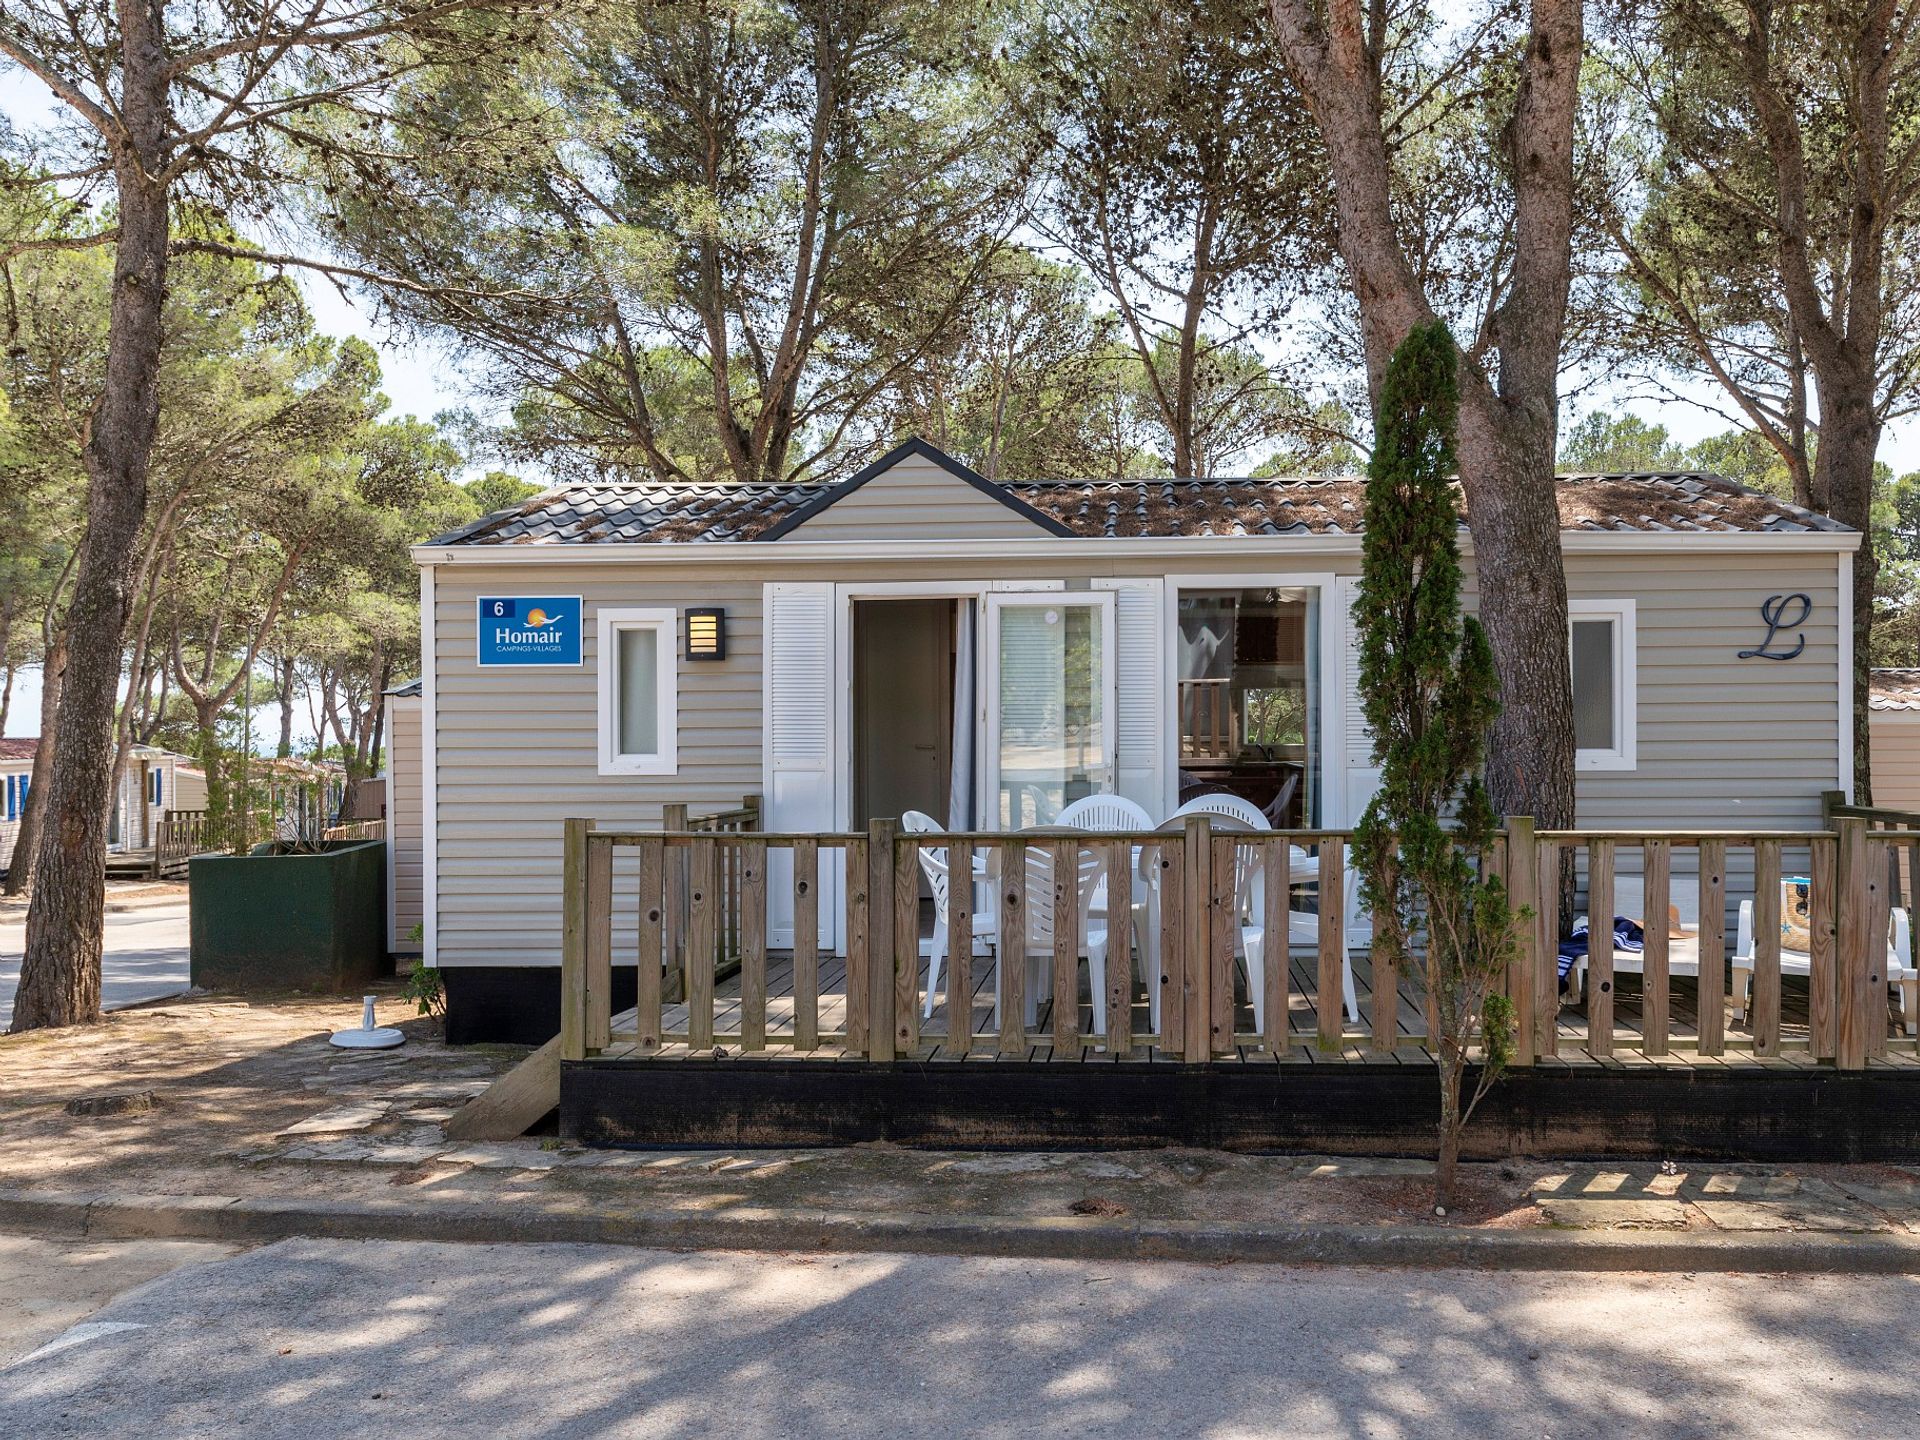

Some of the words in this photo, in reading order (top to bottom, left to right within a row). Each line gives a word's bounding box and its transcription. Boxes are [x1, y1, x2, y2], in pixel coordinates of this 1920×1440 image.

[494, 601, 504, 616] 6
[495, 626, 563, 644] Homair
[1738, 593, 1811, 660] L
